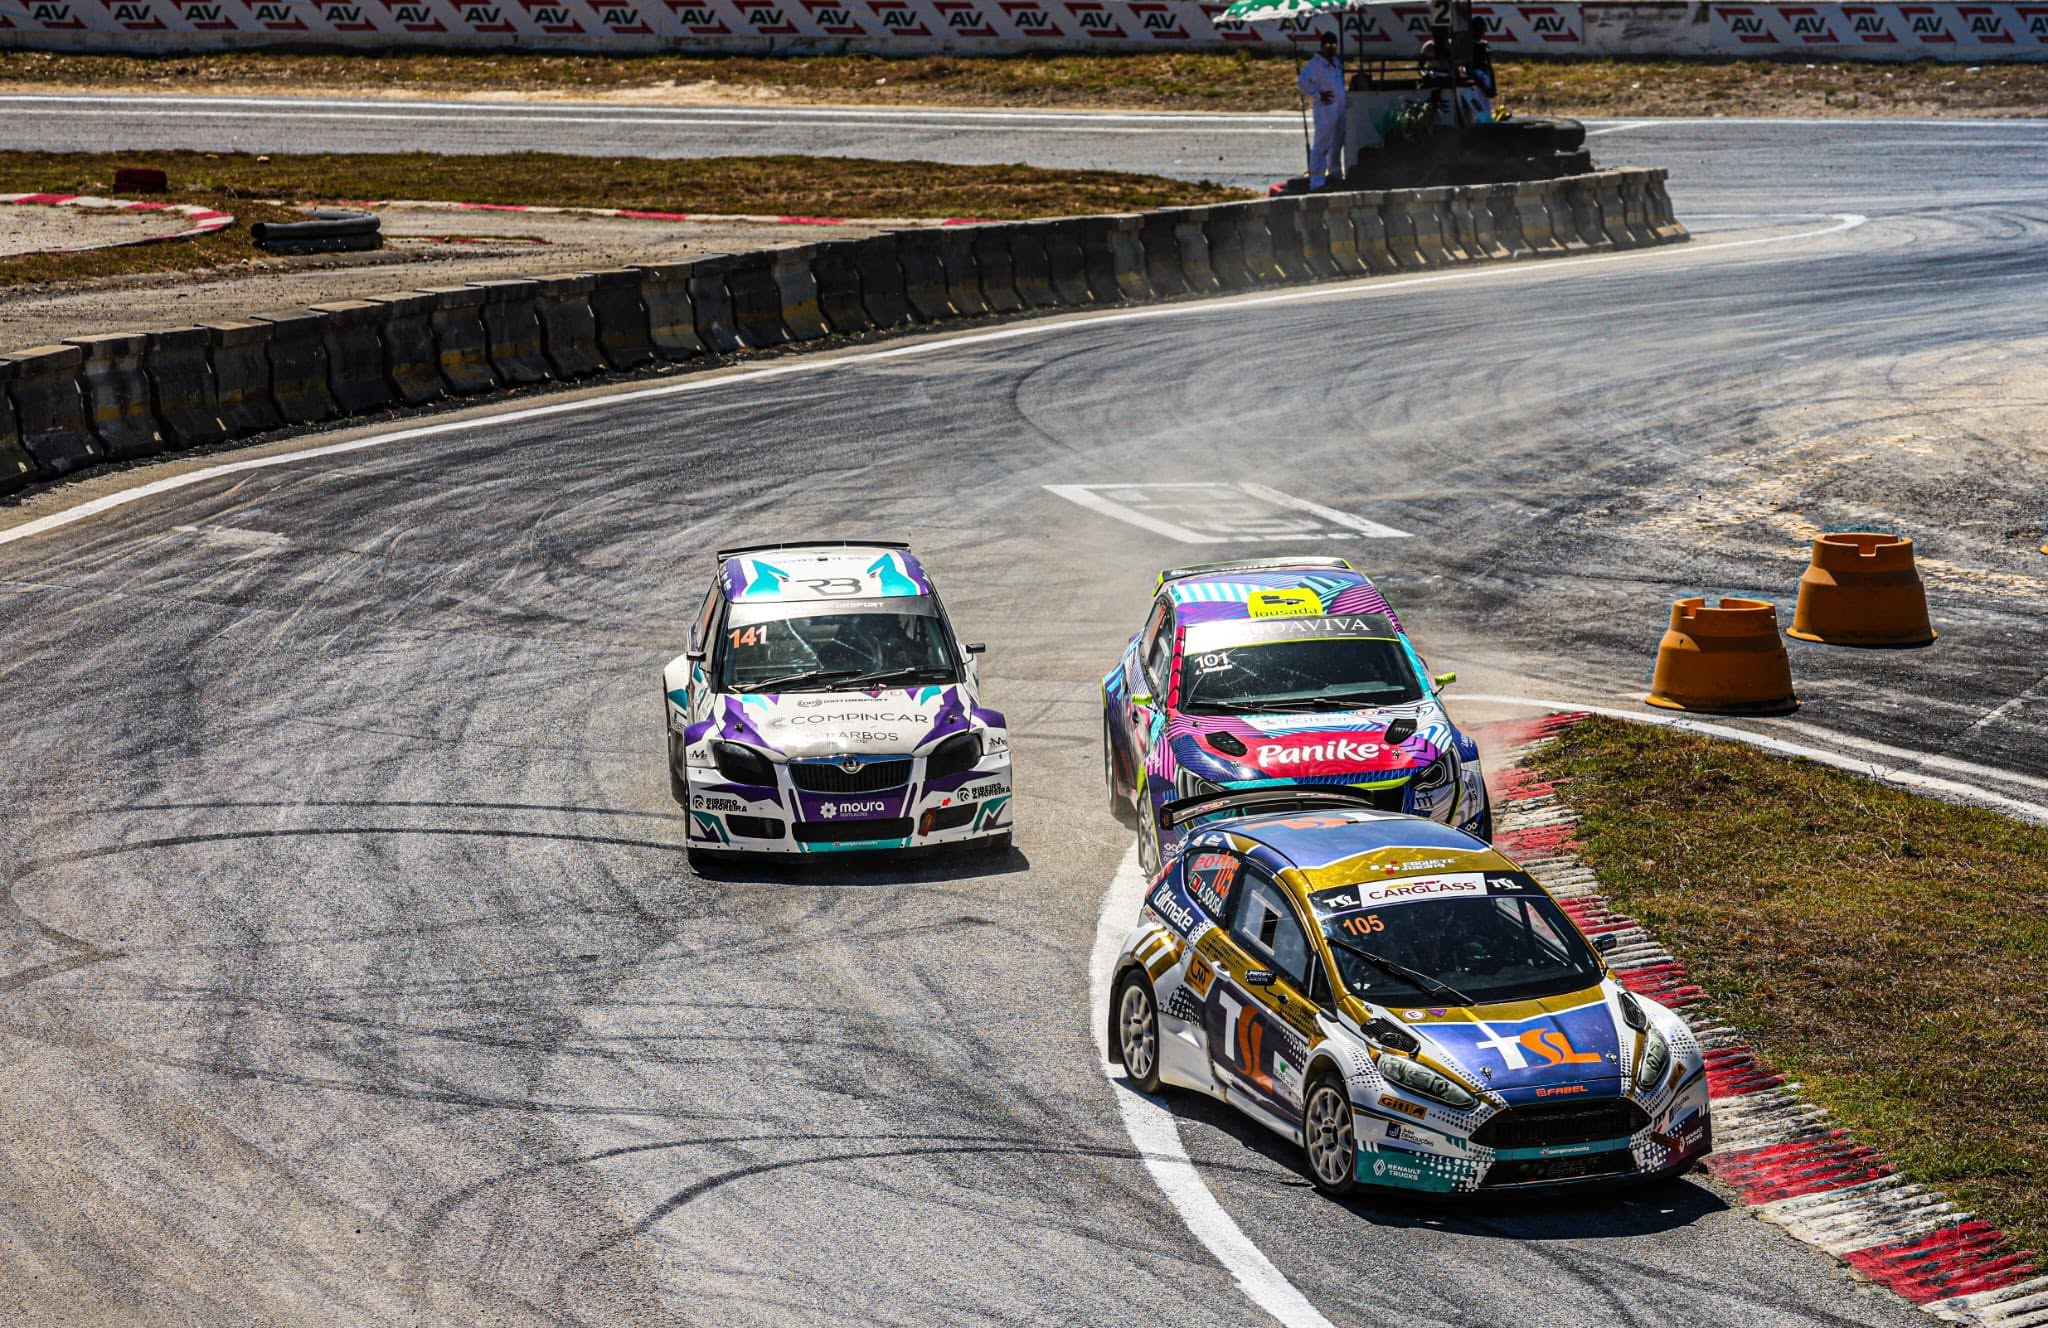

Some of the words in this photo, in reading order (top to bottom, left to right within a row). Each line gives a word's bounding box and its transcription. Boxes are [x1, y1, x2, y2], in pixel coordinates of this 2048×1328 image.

[34, 5, 69, 20] AV
[115, 5, 150, 20] AV
[186, 5, 221, 20] AV
[256, 5, 290, 20] AV
[326, 6, 361, 21] AV
[396, 7, 430, 22] AV
[466, 8, 500, 23] AV
[535, 8, 569, 24] AV
[603, 9, 638, 24] AV
[681, 9, 715, 24] AV
[749, 10, 782, 25] AV
[817, 9, 850, 25] AV
[883, 11, 916, 26] AV
[949, 12, 982, 27] AV
[1015, 12, 1048, 27] AV
[1435, 0, 1450, 24] 2
[1079, 13, 1112, 28] AV
[1144, 13, 1176, 29] AV
[1278, 16, 1311, 32] AV
[1344, 16, 1376, 33] AV
[1533, 17, 1565, 32] AV
[1731, 17, 1763, 33] AV
[1794, 17, 1825, 33] AV
[1855, 16, 1884, 32] AV
[1913, 17, 1942, 32] AV
[1971, 17, 2002, 33] AV
[2030, 17, 2048, 33] A
[1255, 608, 1318, 618] lousada
[728, 625, 768, 648] 141
[1194, 651, 1228, 668] 101
[790, 712, 929, 725] COMPINCAR
[1256, 739, 1380, 768] Panike
[839, 801, 885, 813] moura
[1368, 882, 1477, 900] CARGLASS
[1486, 877, 1524, 891] TSL
[1323, 893, 1361, 908] TSL
[1343, 914, 1385, 936] 105
[1218, 989, 1274, 1097] TSL
[1475, 1027, 1603, 1071] TSL
[1547, 1085, 1589, 1096] FABEL
[1381, 1097, 1409, 1114] Giti
[1387, 1163, 1422, 1175] RENAULT
[1388, 1169, 1418, 1181] TRUCKS
